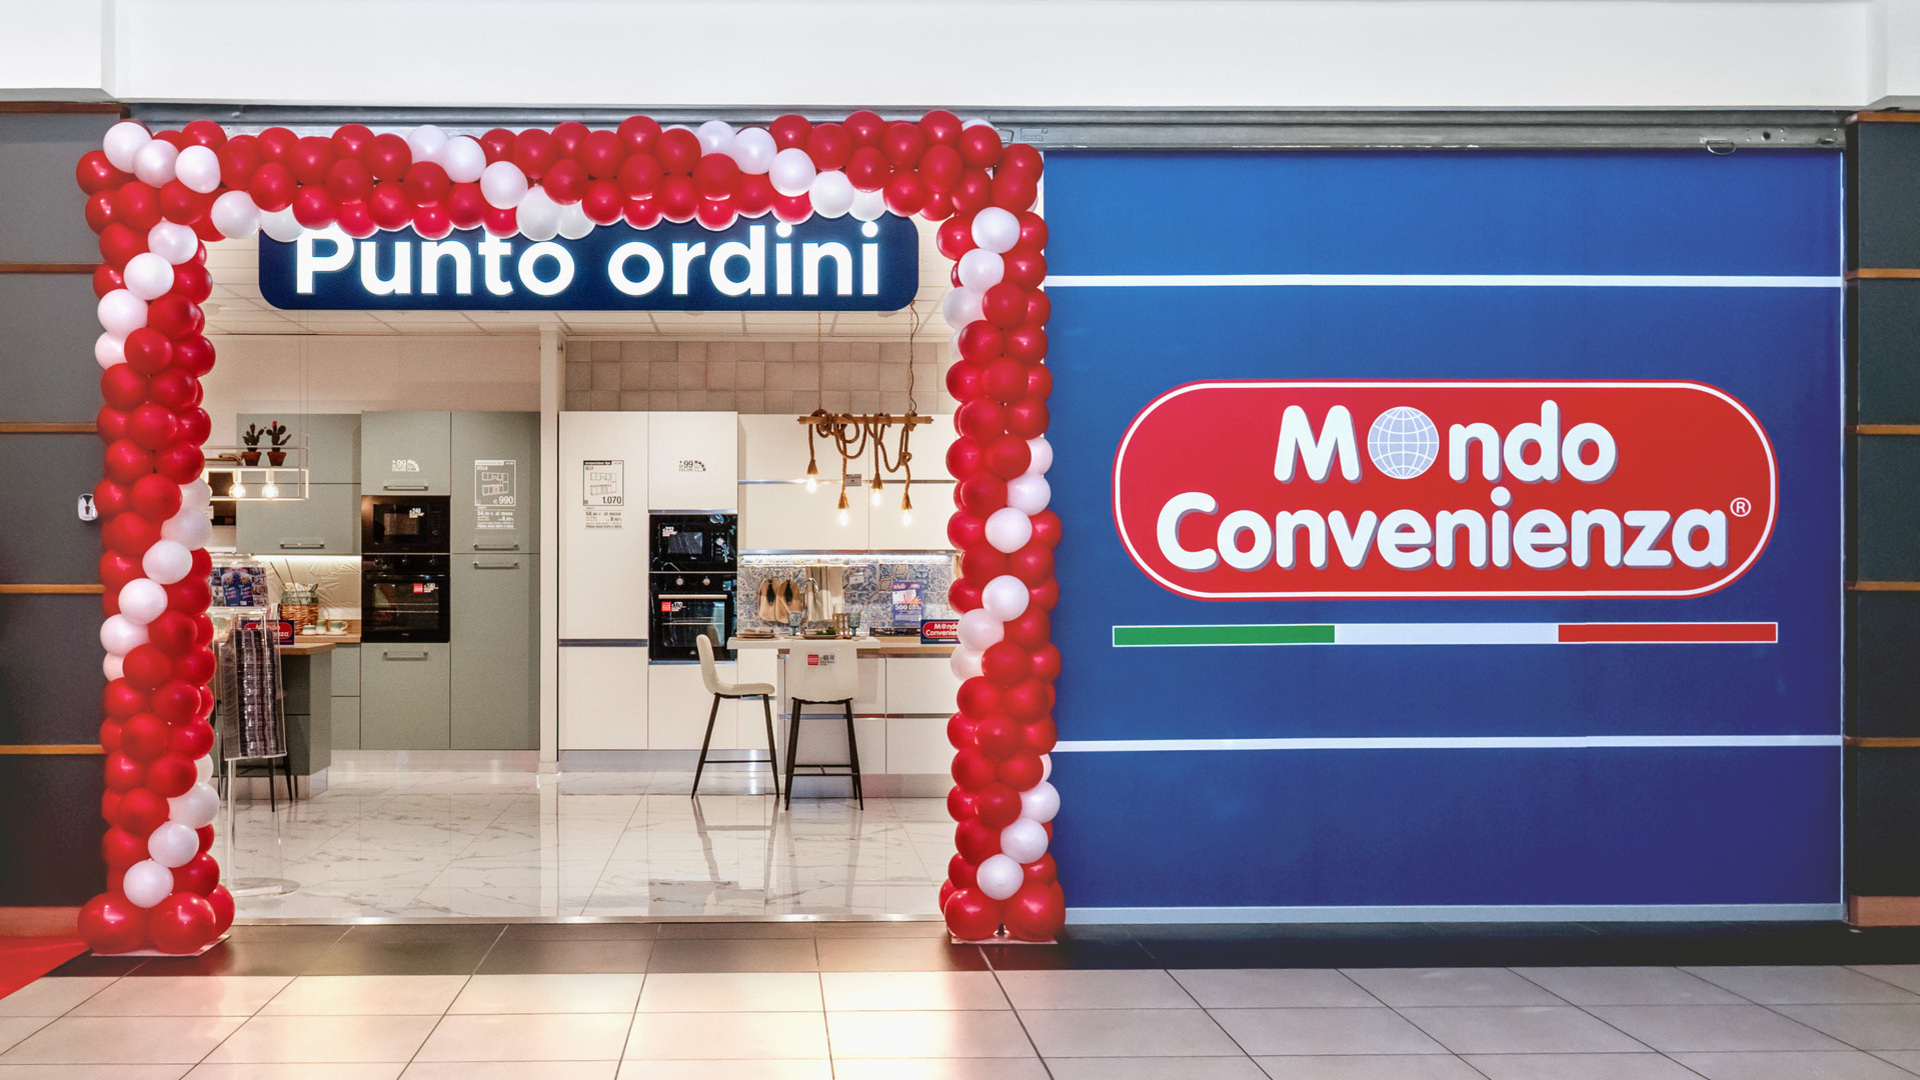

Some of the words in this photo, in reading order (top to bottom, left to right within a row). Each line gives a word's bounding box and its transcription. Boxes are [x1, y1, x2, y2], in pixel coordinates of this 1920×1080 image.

[296, 222, 575, 296] Punto
[607, 220, 879, 296] ordini
[498, 495, 514, 505] 990
